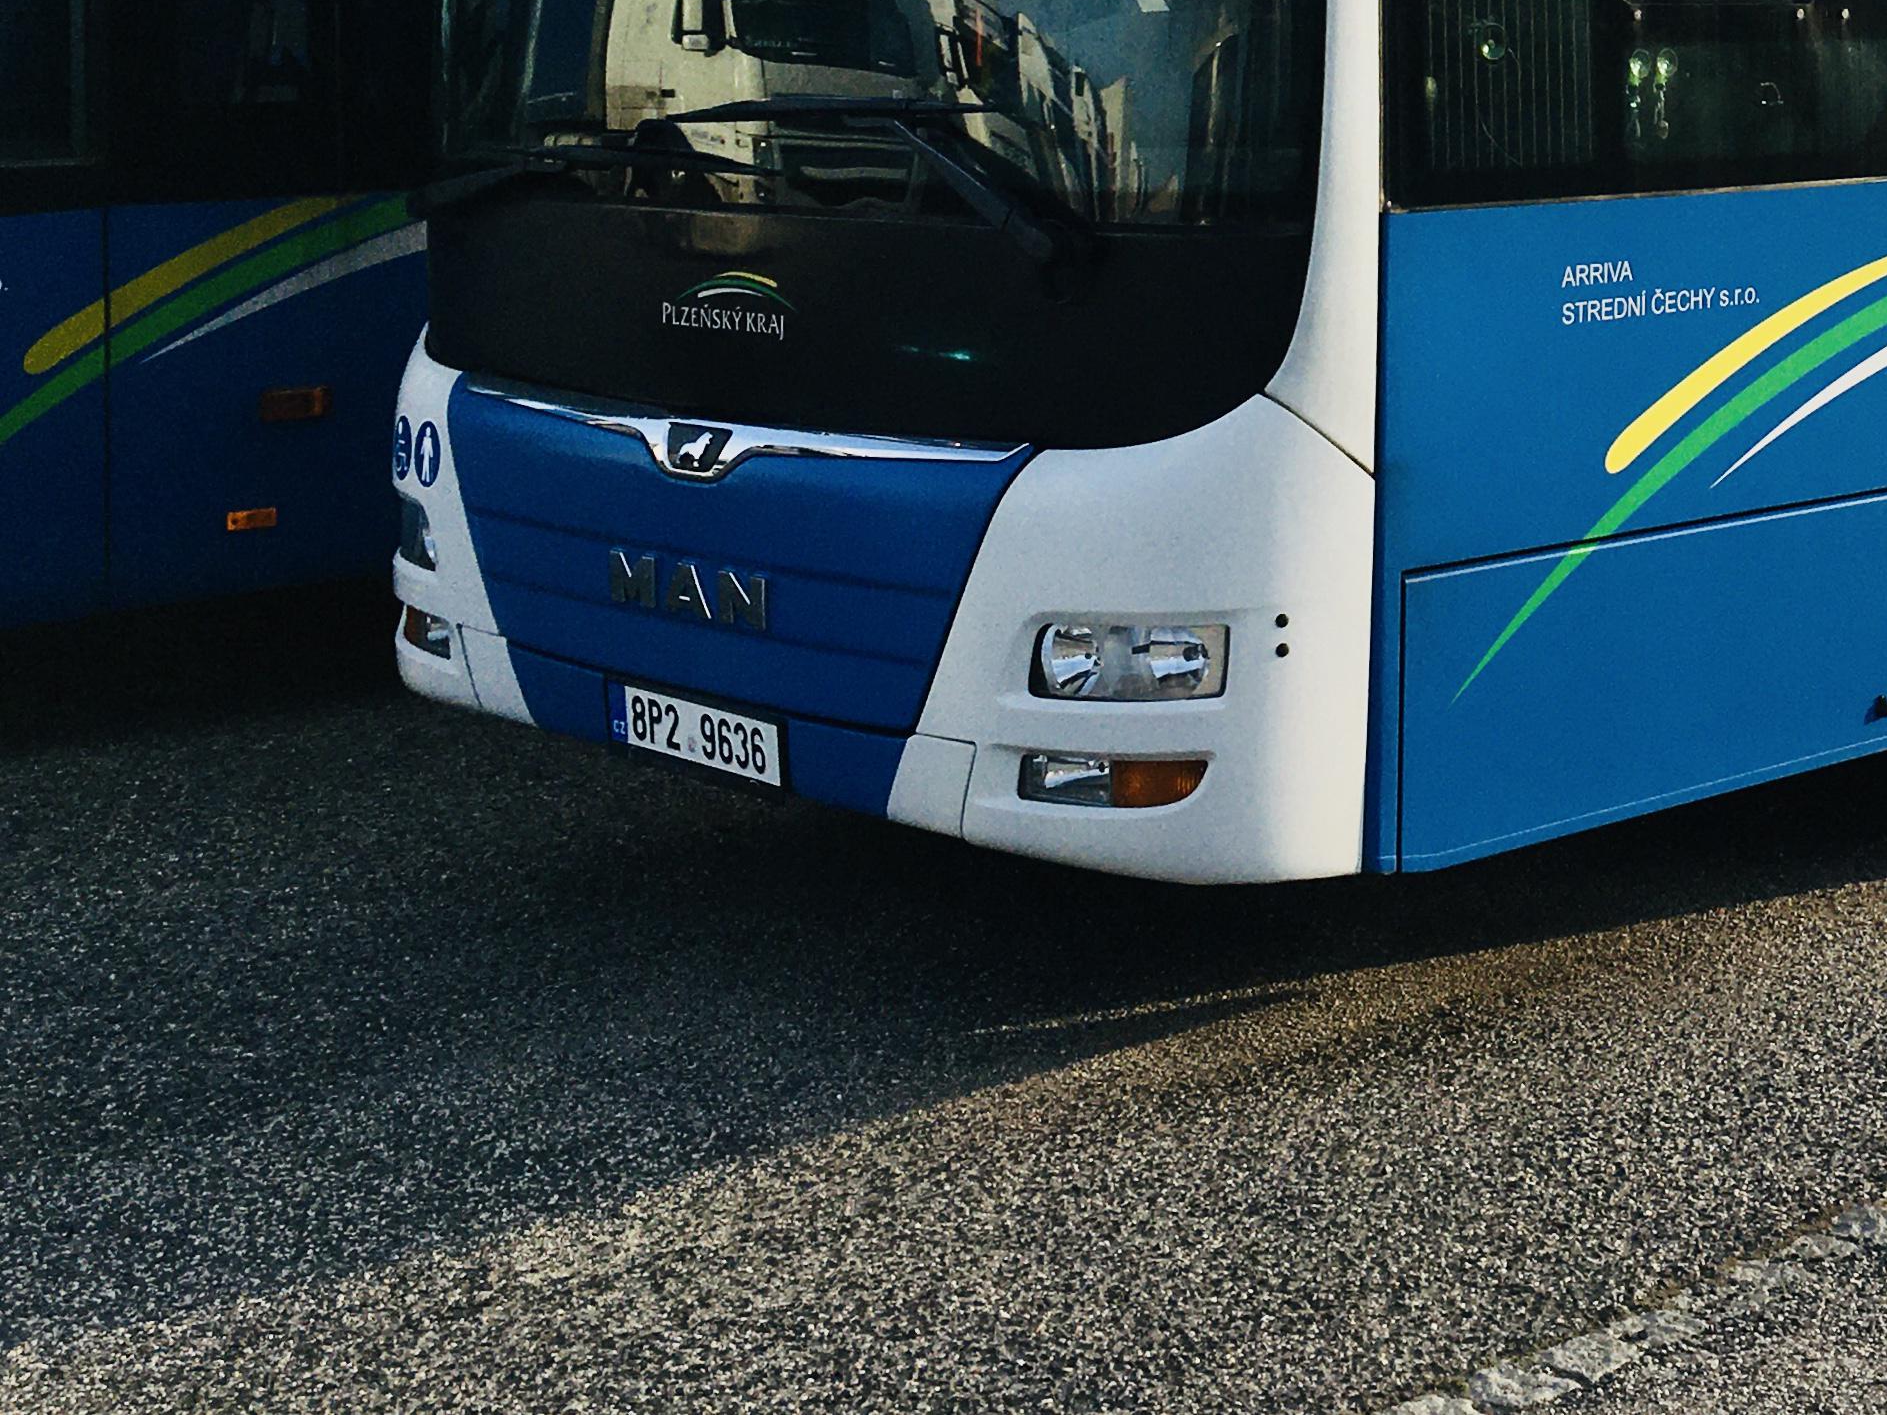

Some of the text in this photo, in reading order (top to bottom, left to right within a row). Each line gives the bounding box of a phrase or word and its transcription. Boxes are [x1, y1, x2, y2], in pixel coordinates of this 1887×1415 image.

[1561, 260, 1633, 288] ARRIVA
[1651, 287, 1715, 315] ČECHY
[1719, 287, 1760, 307] s.r.o.
[746, 312, 785, 341] KRAJ
[609, 548, 768, 631] MAN
[613, 719, 626, 735] CZ
[631, 695, 766, 775] 8P2 9636
